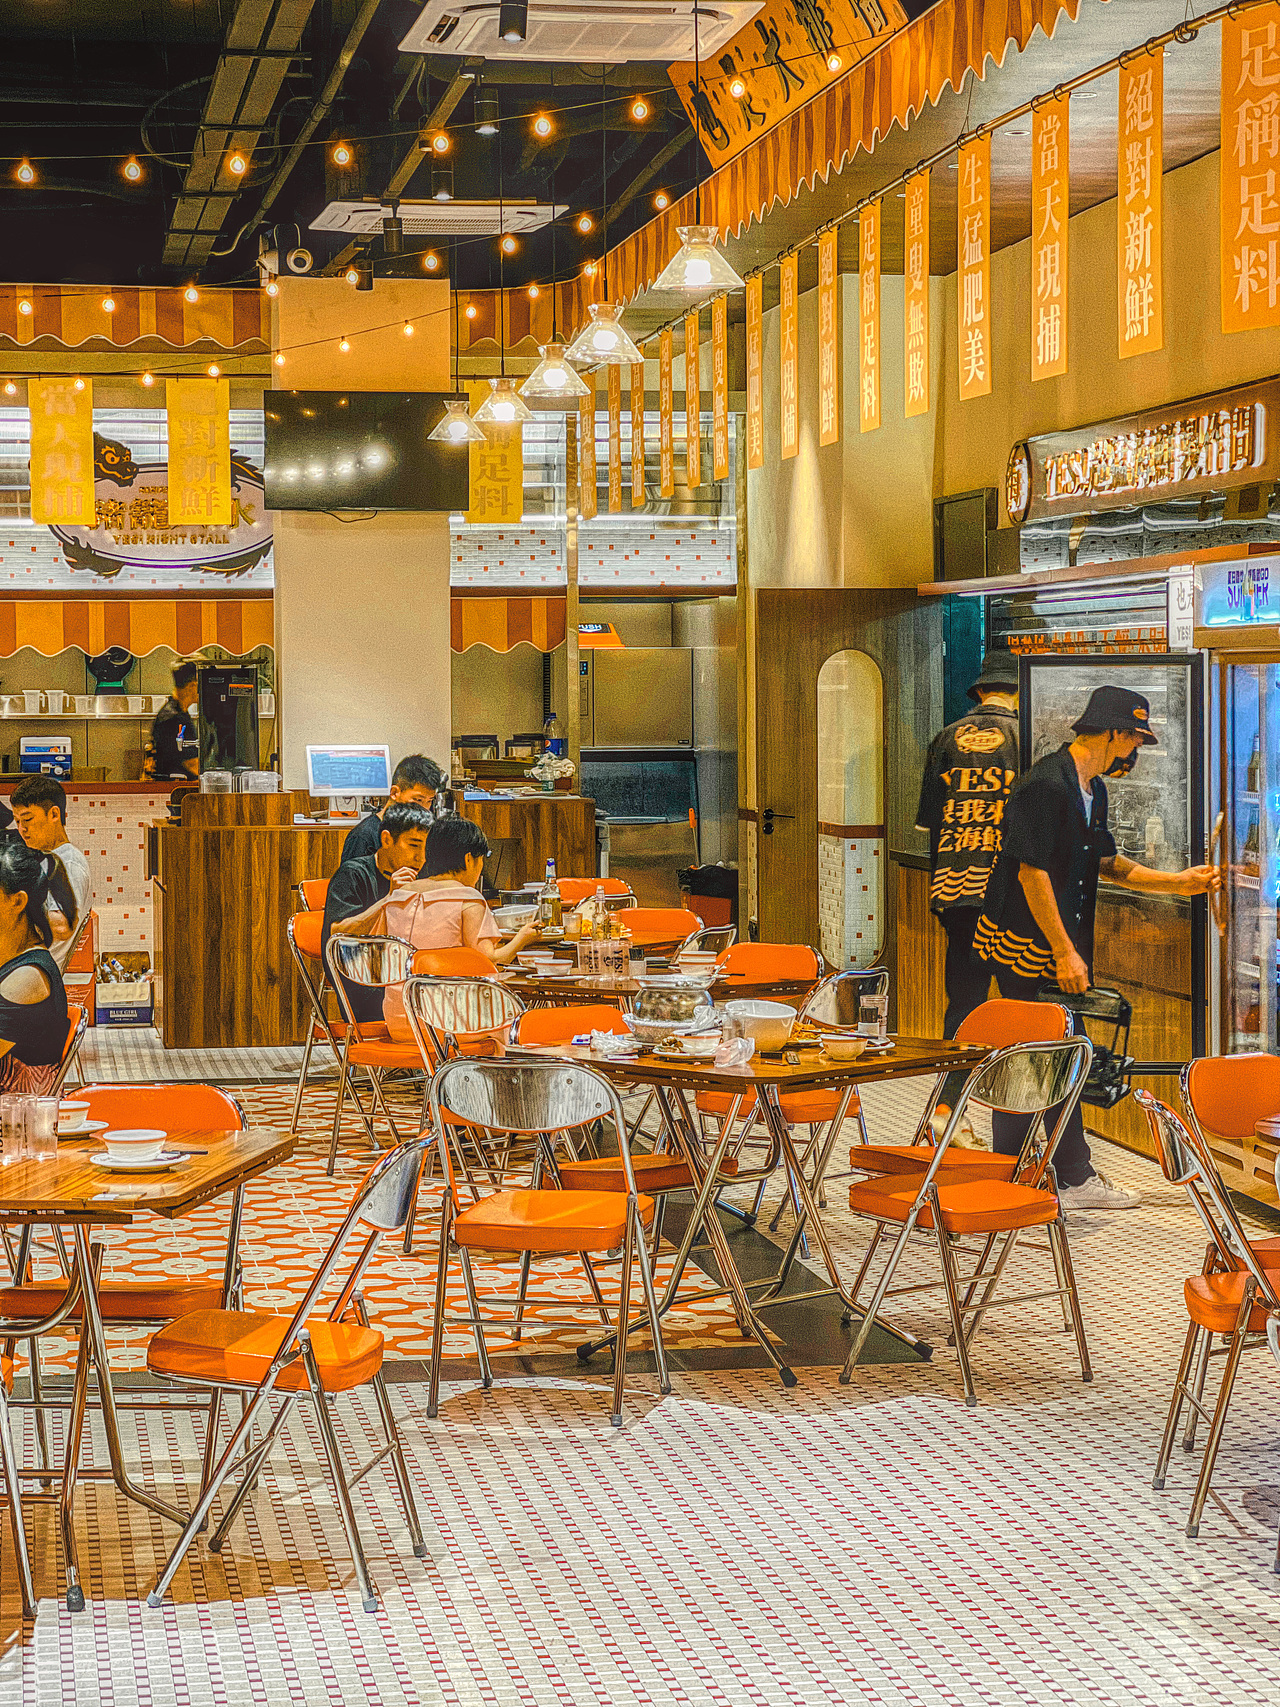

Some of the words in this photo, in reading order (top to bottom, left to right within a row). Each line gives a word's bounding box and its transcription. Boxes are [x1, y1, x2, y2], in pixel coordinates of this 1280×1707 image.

[908, 187, 925, 404] 童叟無欺
[963, 153, 985, 386] 生猛肥美
[1036, 114, 1062, 366] 當天現捕
[1124, 67, 1154, 342] 絕對新鮮
[748, 289, 761, 459] 生猛肥美
[783, 266, 795, 448] 當天現捕
[821, 241, 834, 435] 絕對新鮮
[862, 216, 877, 421] 足稱足料
[146, 534, 187, 545] NIGHT
[1227, 582, 1269, 609] SUMER
[940, 766, 1016, 795] YES!
